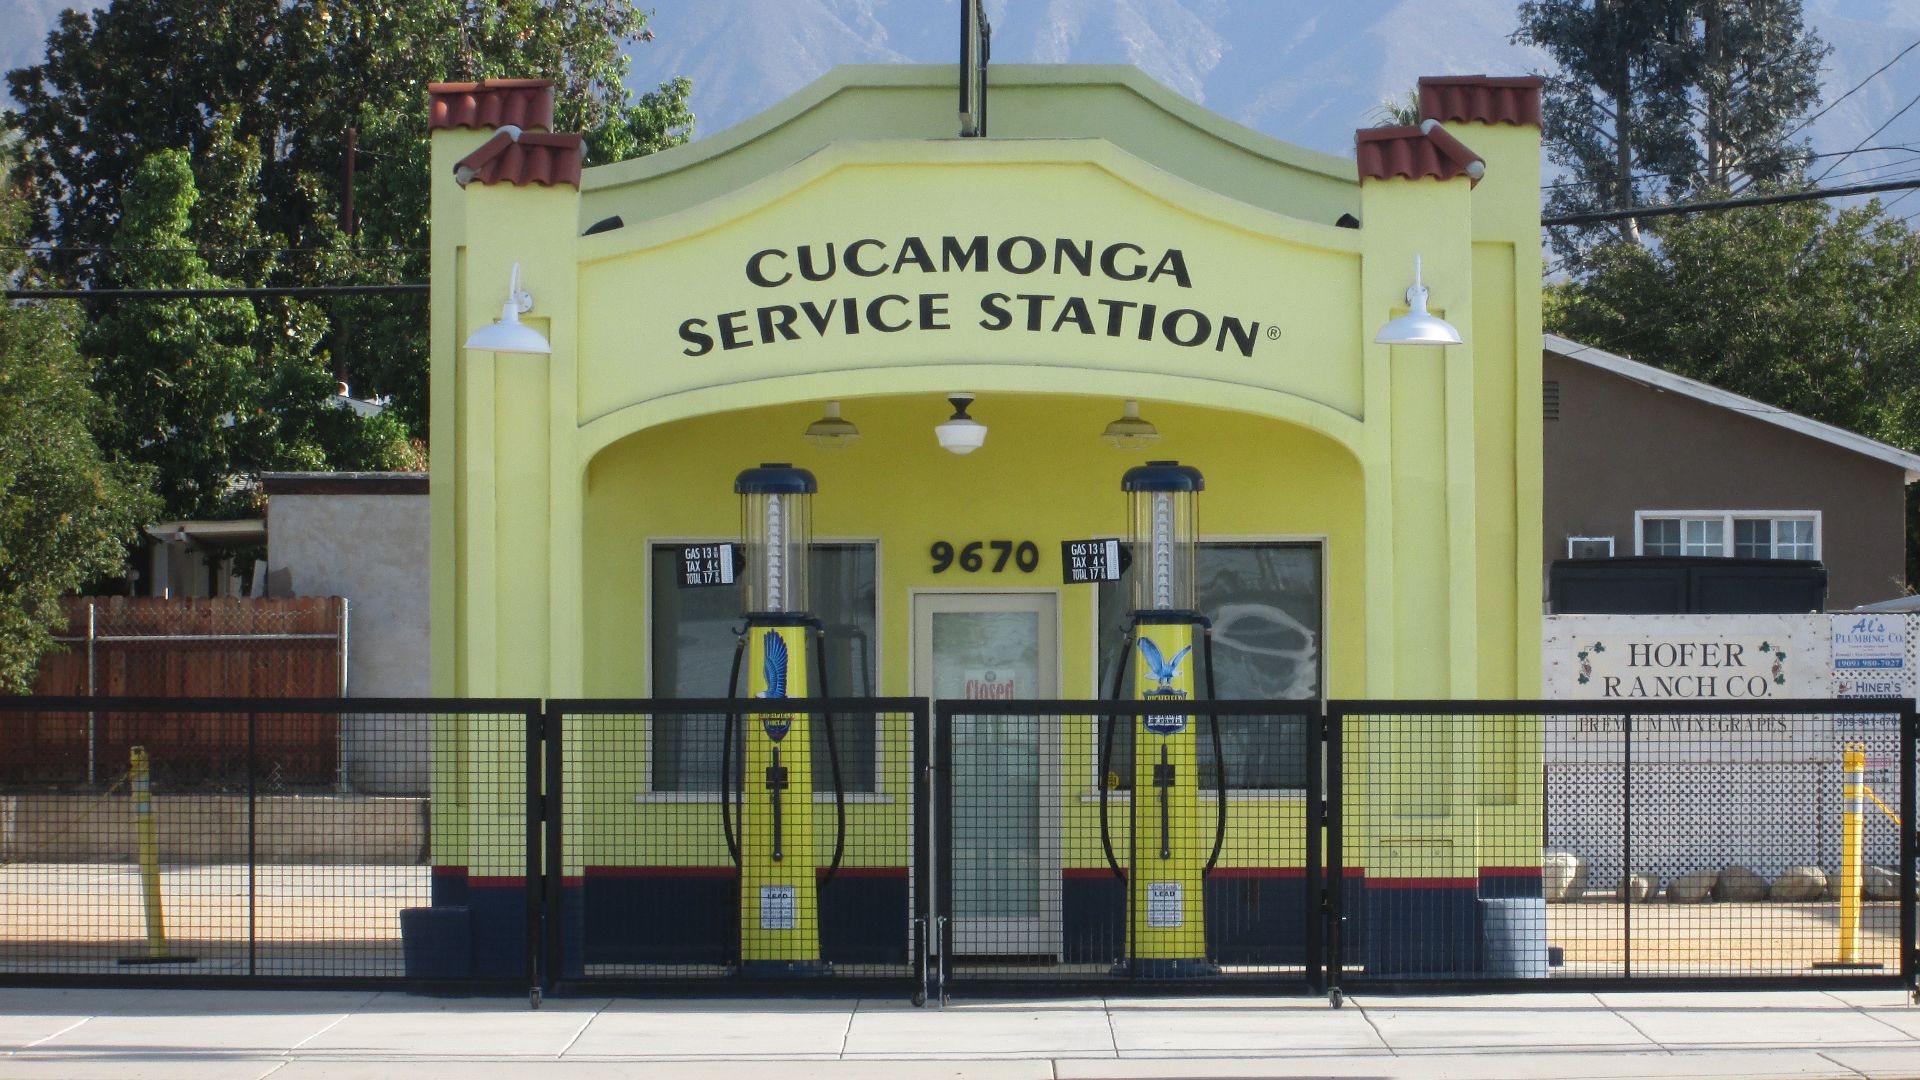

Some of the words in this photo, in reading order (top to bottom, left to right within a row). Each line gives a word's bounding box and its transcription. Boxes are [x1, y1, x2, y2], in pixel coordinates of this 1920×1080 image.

[745, 235, 1193, 289] CUCAMONGA
[678, 293, 951, 357] SERVICE
[978, 292, 1260, 357] STATION
[685, 547, 700, 560] GAS
[702, 547, 712, 559] 13
[1071, 543, 1087, 555] GAS
[1088, 543, 1098, 555] 13
[930, 540, 1040, 574] 9670
[1072, 556, 1087, 568] TAX
[685, 560, 701, 572] TAX
[685, 573, 702, 584] TOTAL
[703, 572, 712, 584] 17
[1072, 568, 1088, 580] TOTAL
[1089, 568, 1099, 580] 17
[1851, 617, 1886, 633] Al's
[1627, 642, 1747, 668] HOFER
[1603, 675, 1718, 698] RANCH
[1725, 675, 1773, 698] CO.
[1855, 681, 1902, 693] HINER'S
[1669, 717, 1787, 732] WINEGRAPES
